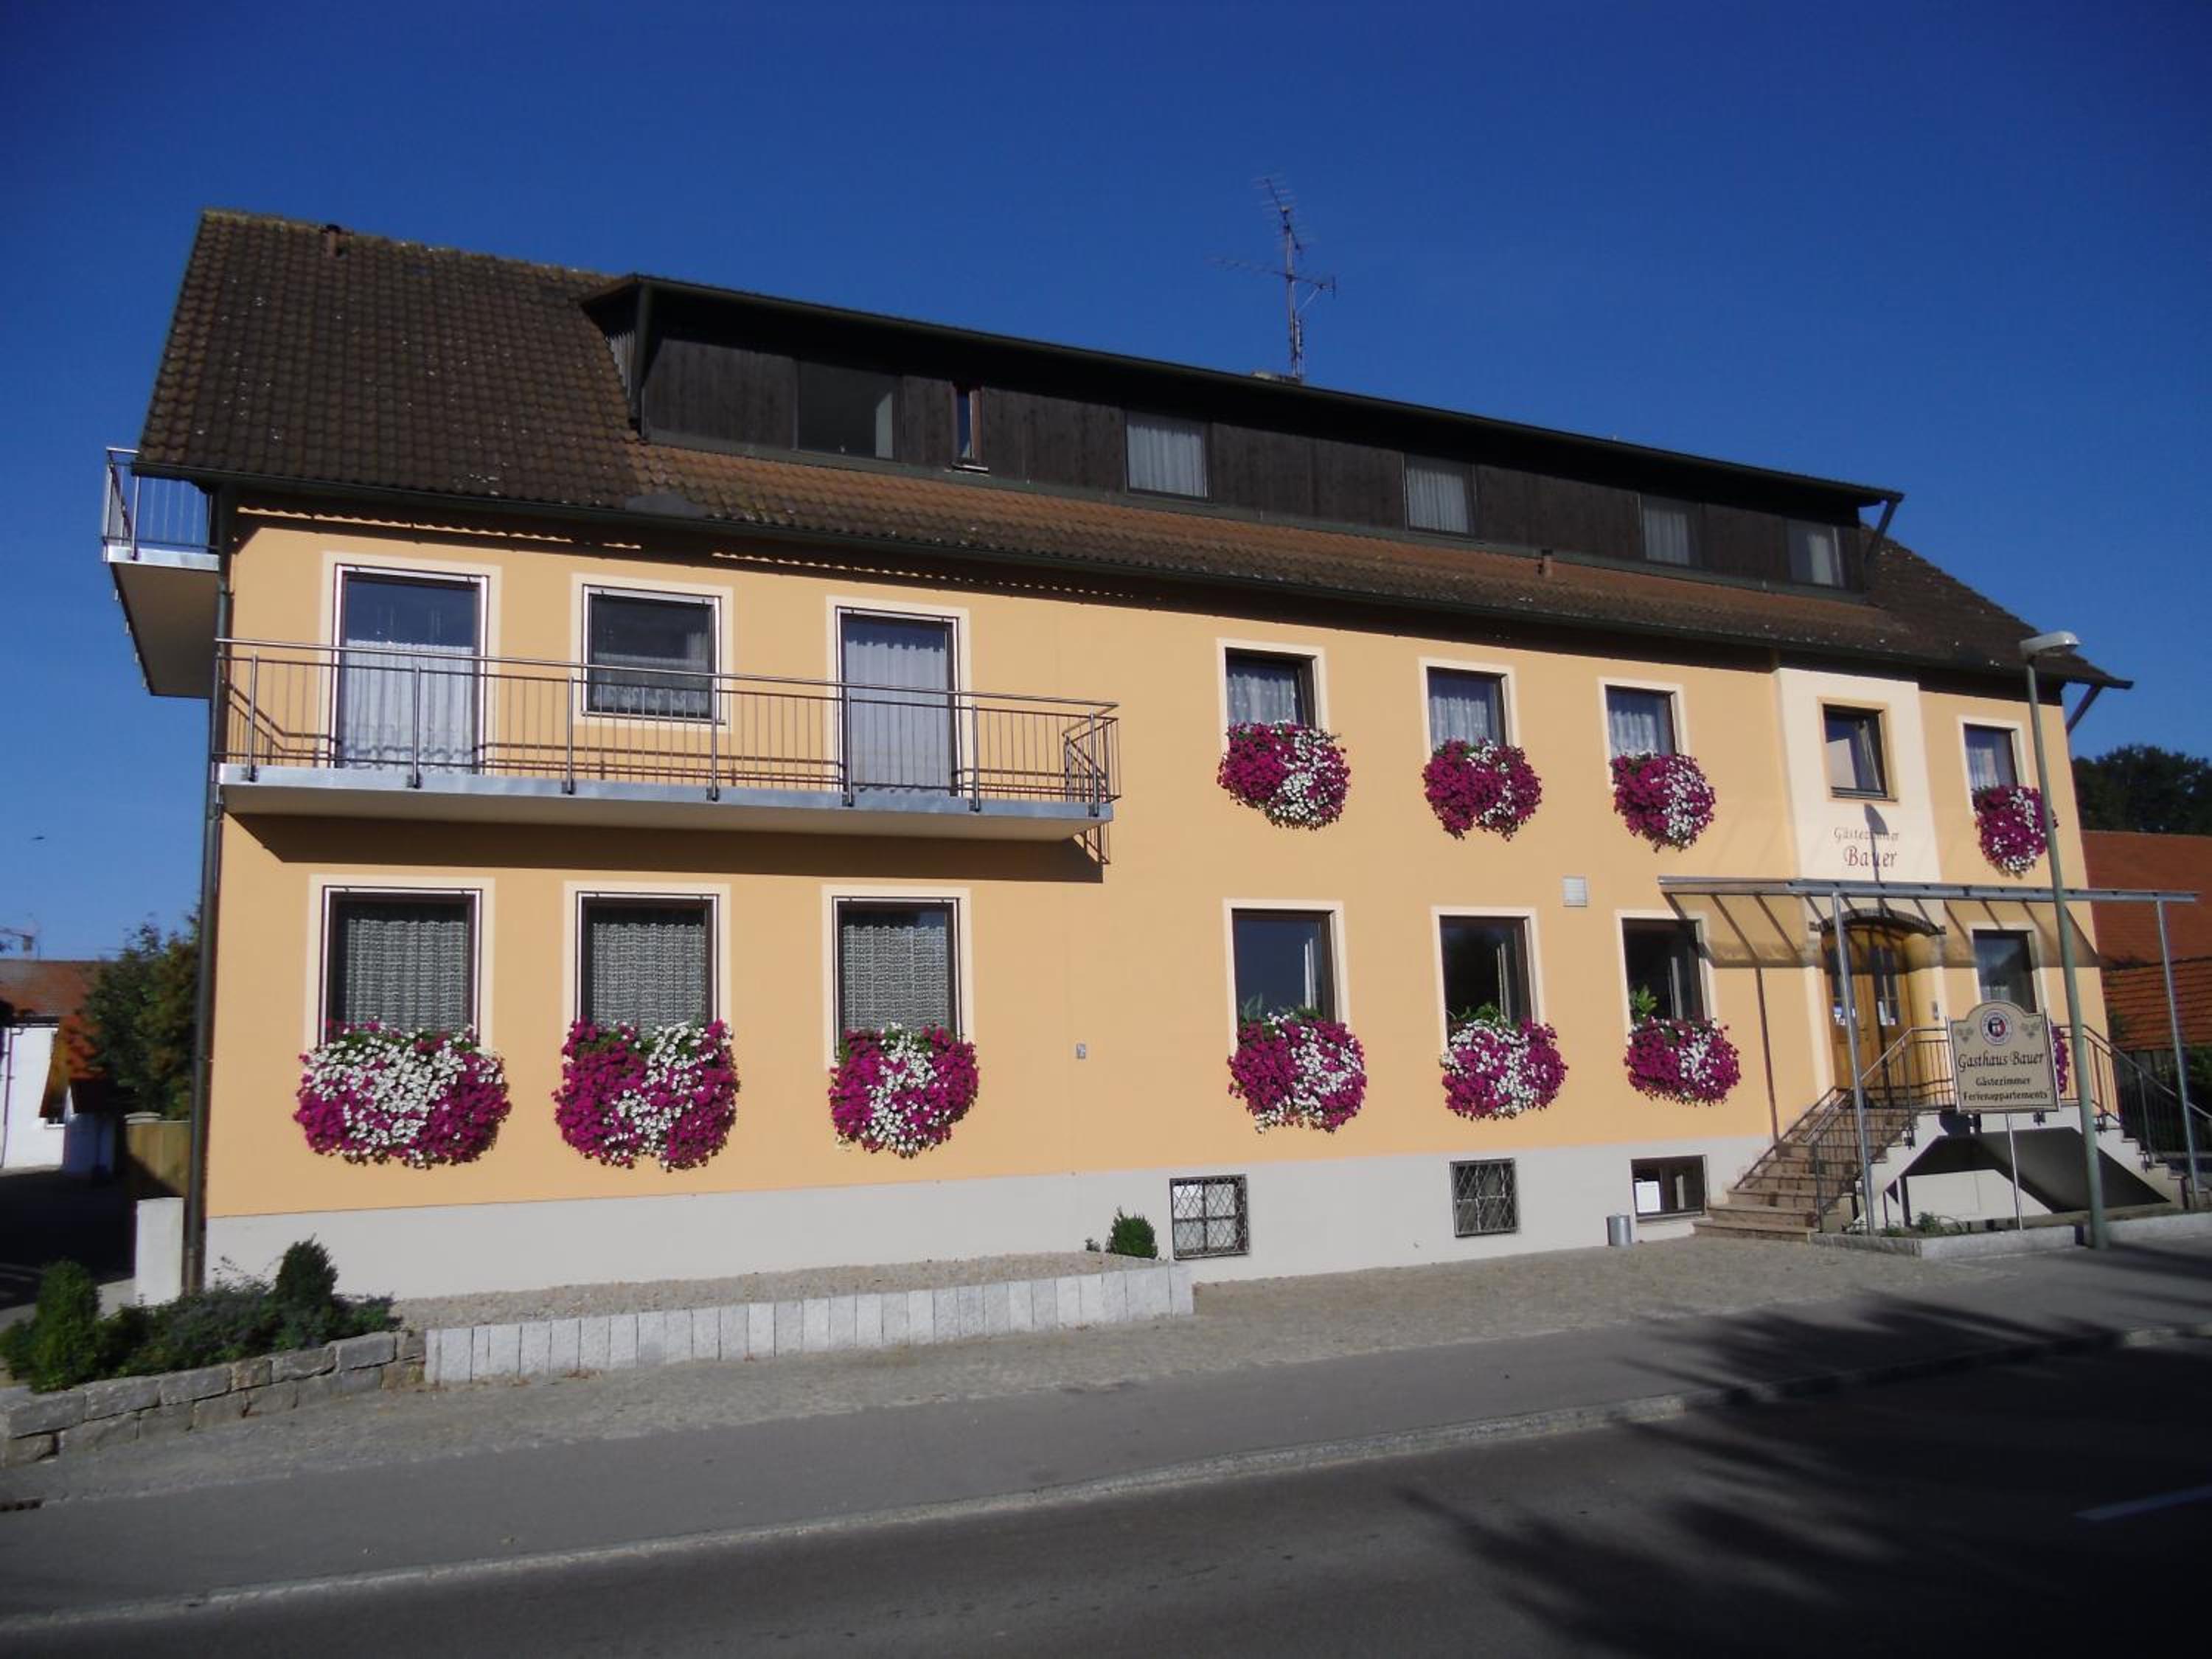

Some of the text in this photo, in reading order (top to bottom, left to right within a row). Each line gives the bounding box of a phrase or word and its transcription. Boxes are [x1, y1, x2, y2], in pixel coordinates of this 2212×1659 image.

[1844, 846, 1897, 866] Bauer
[1958, 1050, 2044, 1072] Gasthaus Bauer
[1976, 1077, 2030, 1086] Gästezimmer
